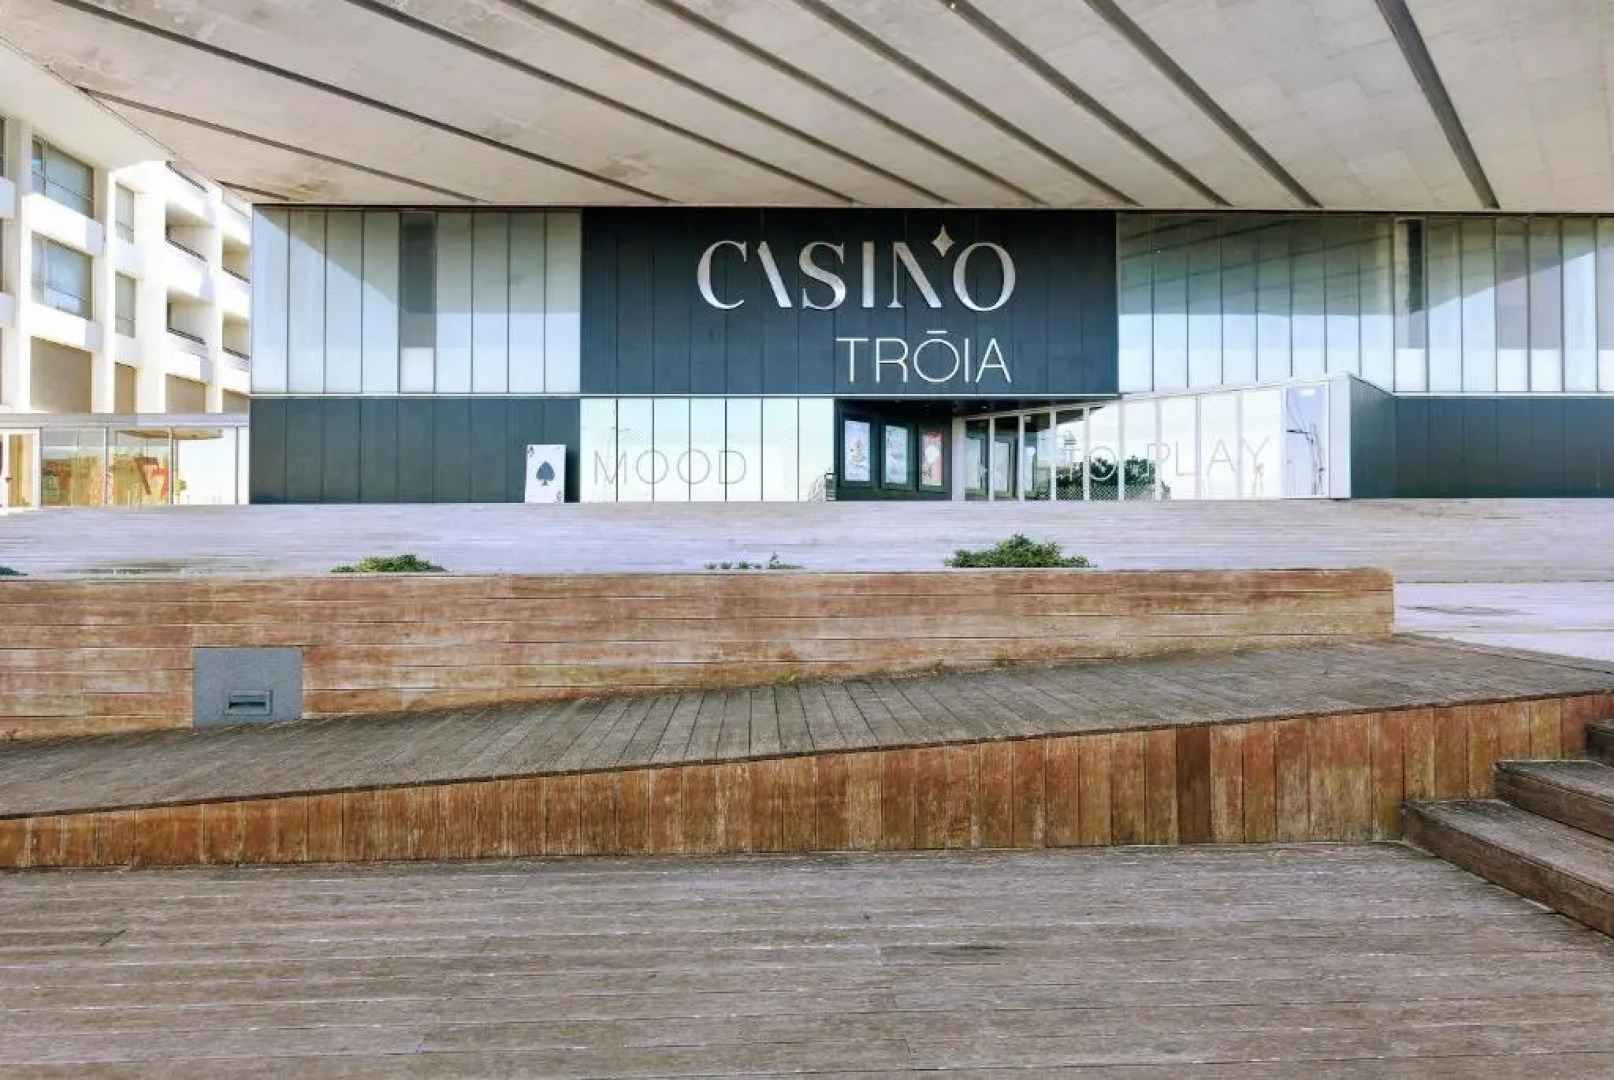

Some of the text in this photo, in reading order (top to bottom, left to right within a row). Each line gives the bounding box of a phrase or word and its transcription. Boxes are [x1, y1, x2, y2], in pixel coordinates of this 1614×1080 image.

[697, 239, 1016, 312] CASINO
[594, 449, 747, 485] MOOD
[1061, 435, 1270, 482] TO PLAY
